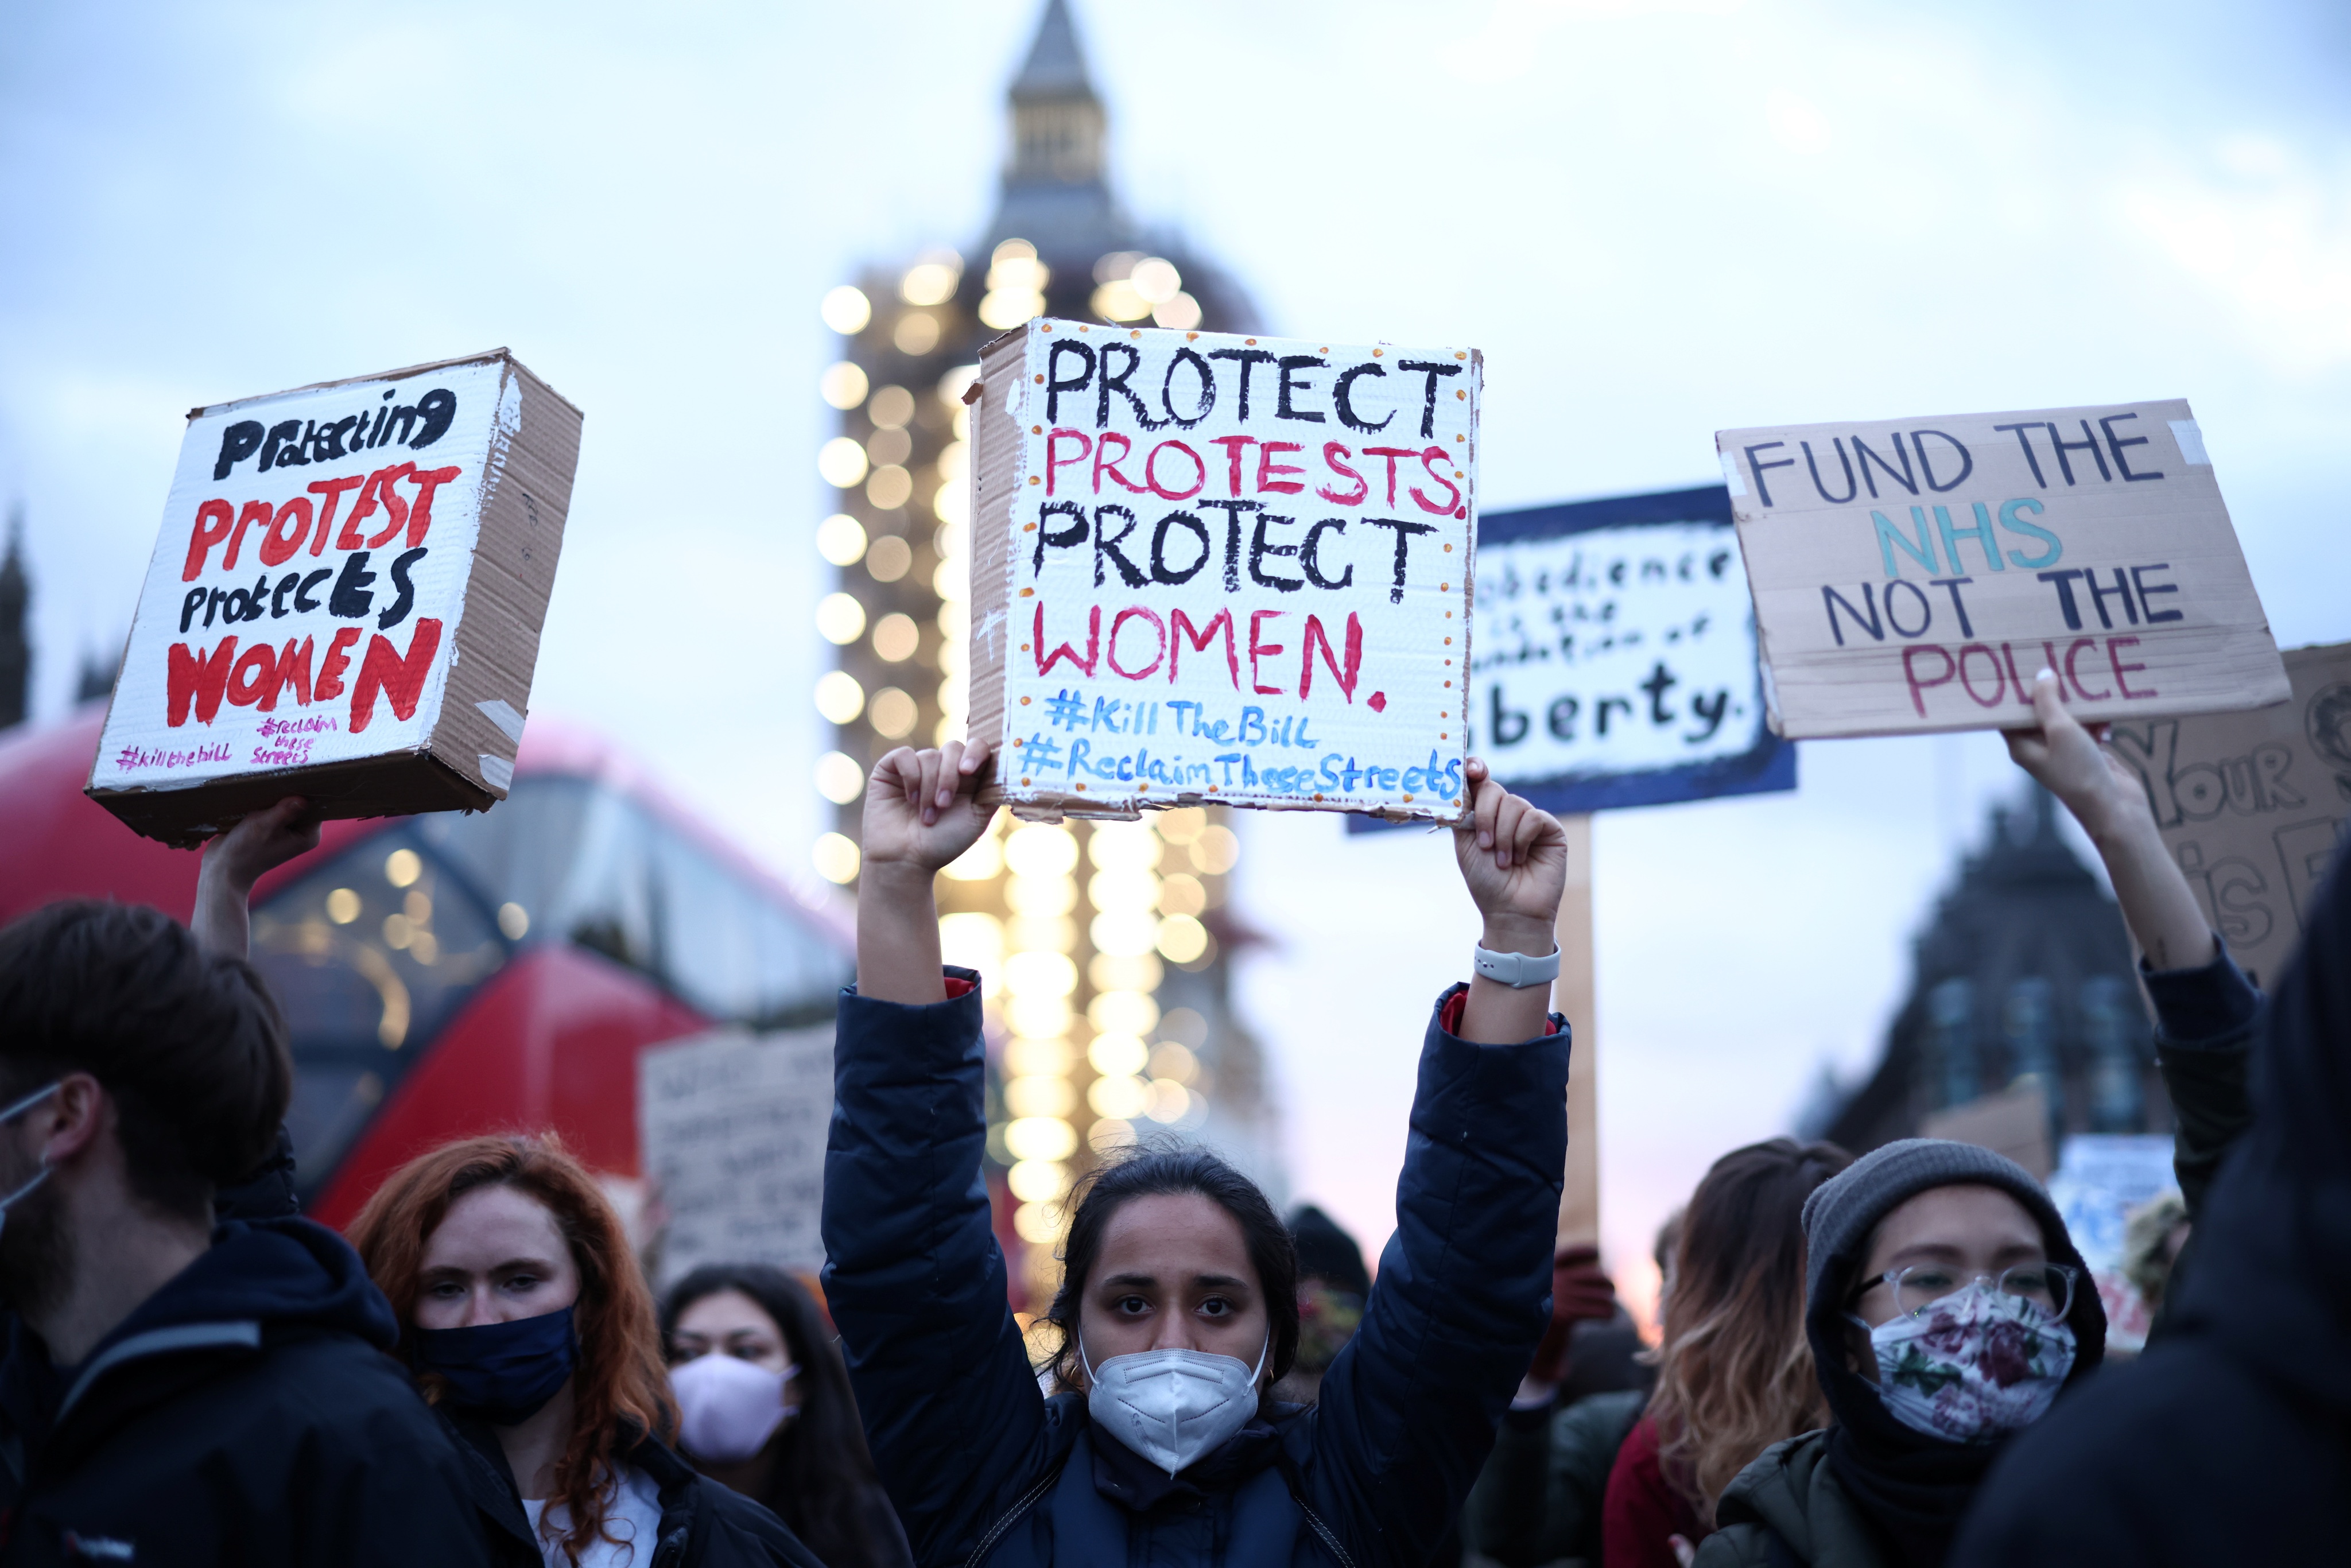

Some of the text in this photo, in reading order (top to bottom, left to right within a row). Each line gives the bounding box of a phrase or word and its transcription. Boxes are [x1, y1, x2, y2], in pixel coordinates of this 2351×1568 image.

[1046, 339, 1463, 439] PROTECT
[1045, 427, 1467, 519] PROTESTS.
[1744, 412, 2164, 507] FUND THE
[1033, 499, 1439, 604] PROTECT
[1870, 497, 2063, 579] NHS
[1821, 563, 2183, 646] NOT THE
[166, 618, 443, 733] WOMEN
[1033, 600, 1387, 712] WOMEN.
[1902, 636, 2158, 719] POLICE
[256, 715, 337, 738] #reclaim
[274, 735, 316, 751] these
[1467, 663, 1743, 750] berty.
[115, 742, 233, 774] #killthebill
